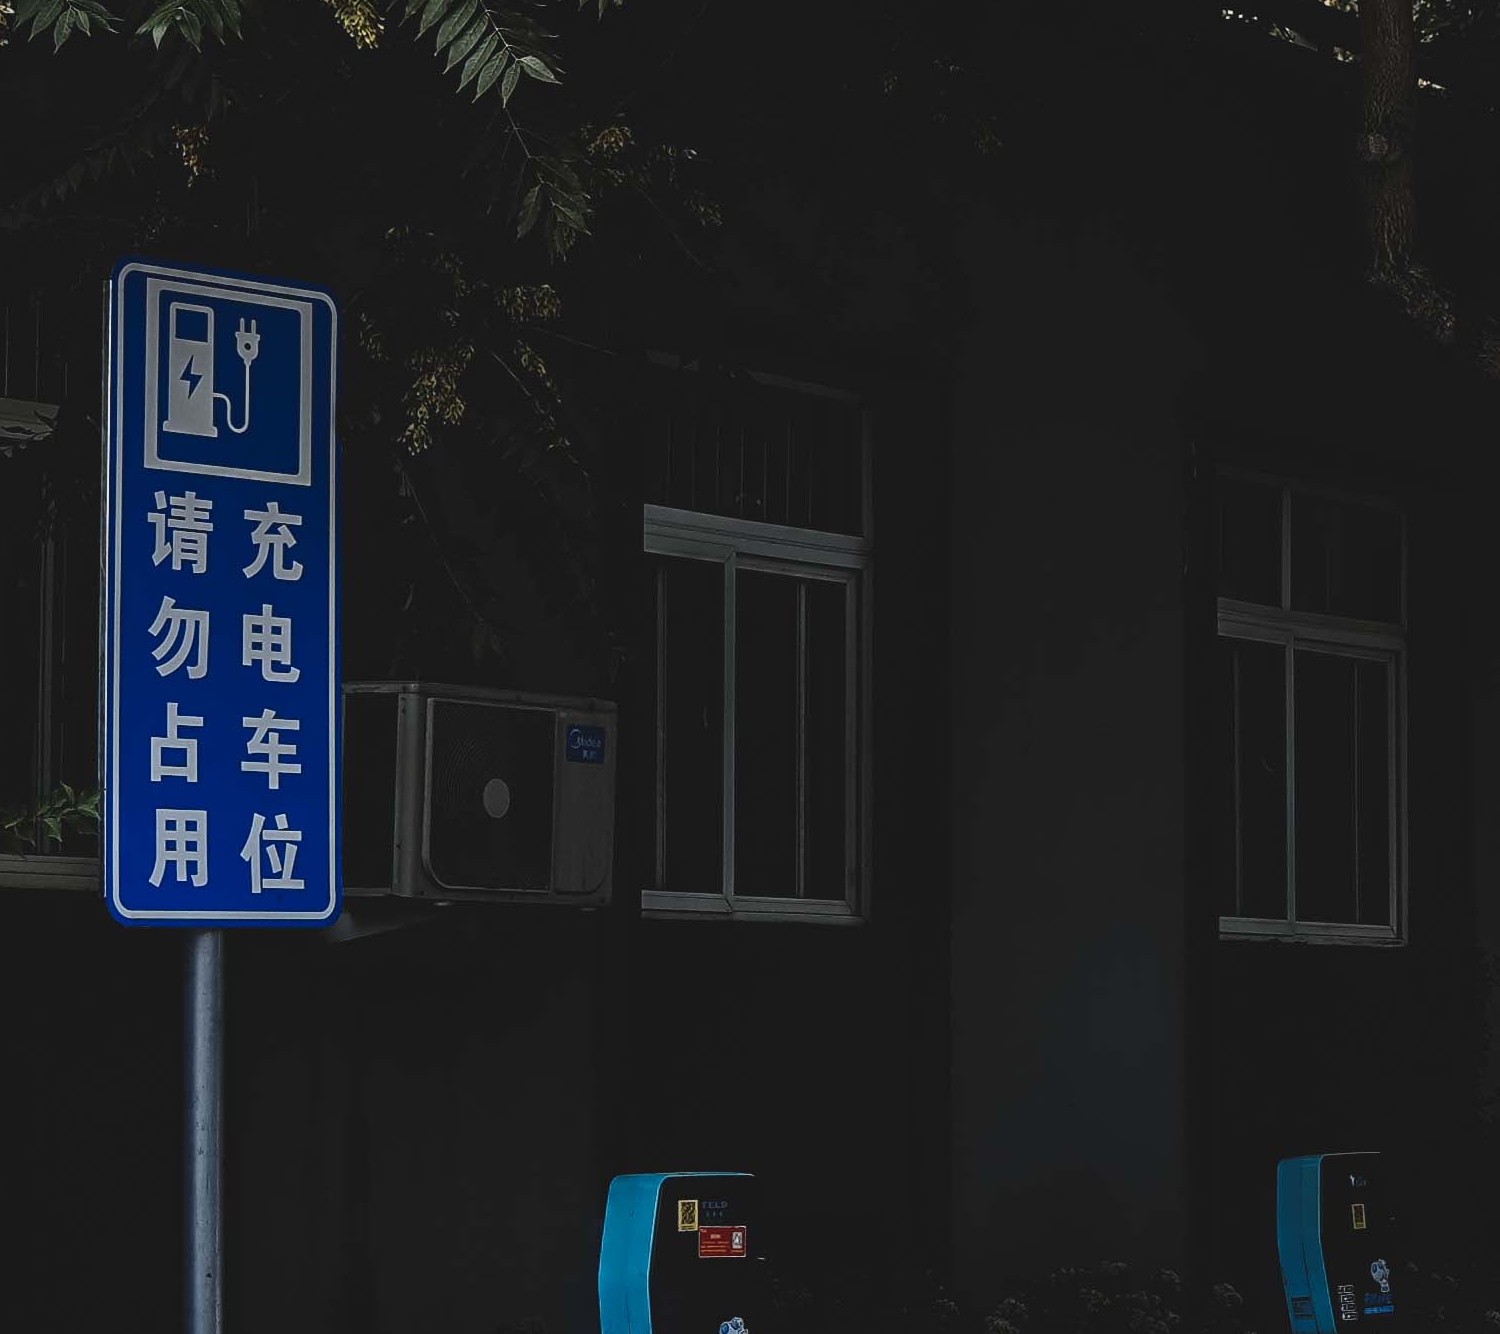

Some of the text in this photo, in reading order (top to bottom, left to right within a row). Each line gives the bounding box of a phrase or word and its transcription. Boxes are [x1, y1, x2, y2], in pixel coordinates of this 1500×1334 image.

[148, 491, 214, 888] 请勿占用
[240, 502, 305, 894] 充电车位
